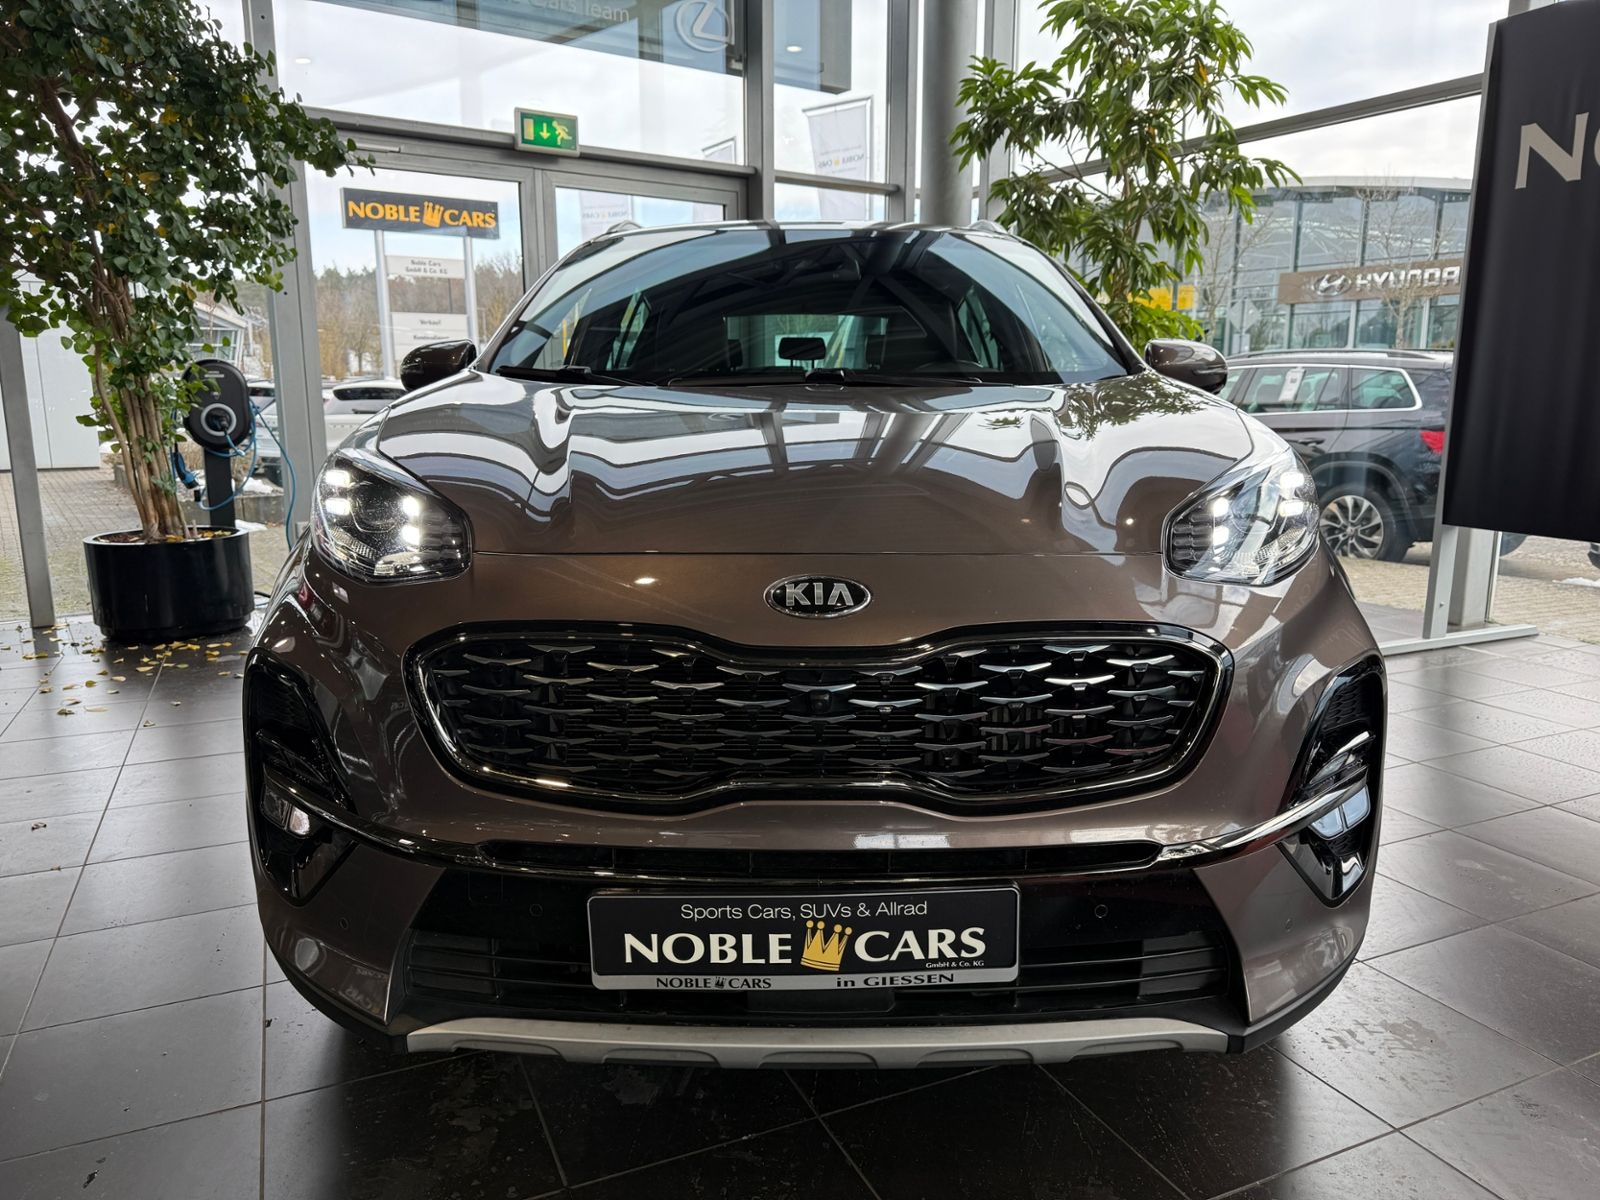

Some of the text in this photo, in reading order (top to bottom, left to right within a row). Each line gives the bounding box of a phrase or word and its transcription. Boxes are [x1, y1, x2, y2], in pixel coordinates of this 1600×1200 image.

[585, 0, 629, 22] Team
[1515, 112, 1600, 189] N
[347, 200, 497, 228] NOBLE CARS
[1356, 266, 1461, 292] HYUNDA
[785, 582, 854, 607] KIA
[681, 901, 927, 922] Sports Cars, SUVs & Allrad
[624, 927, 986, 964] NOBLE CARS
[925, 961, 950, 969] GmbH
[959, 960, 971, 968] Co.
[656, 977, 772, 989] NOBLE CARS
[836, 973, 954, 988] in GIESSEN
